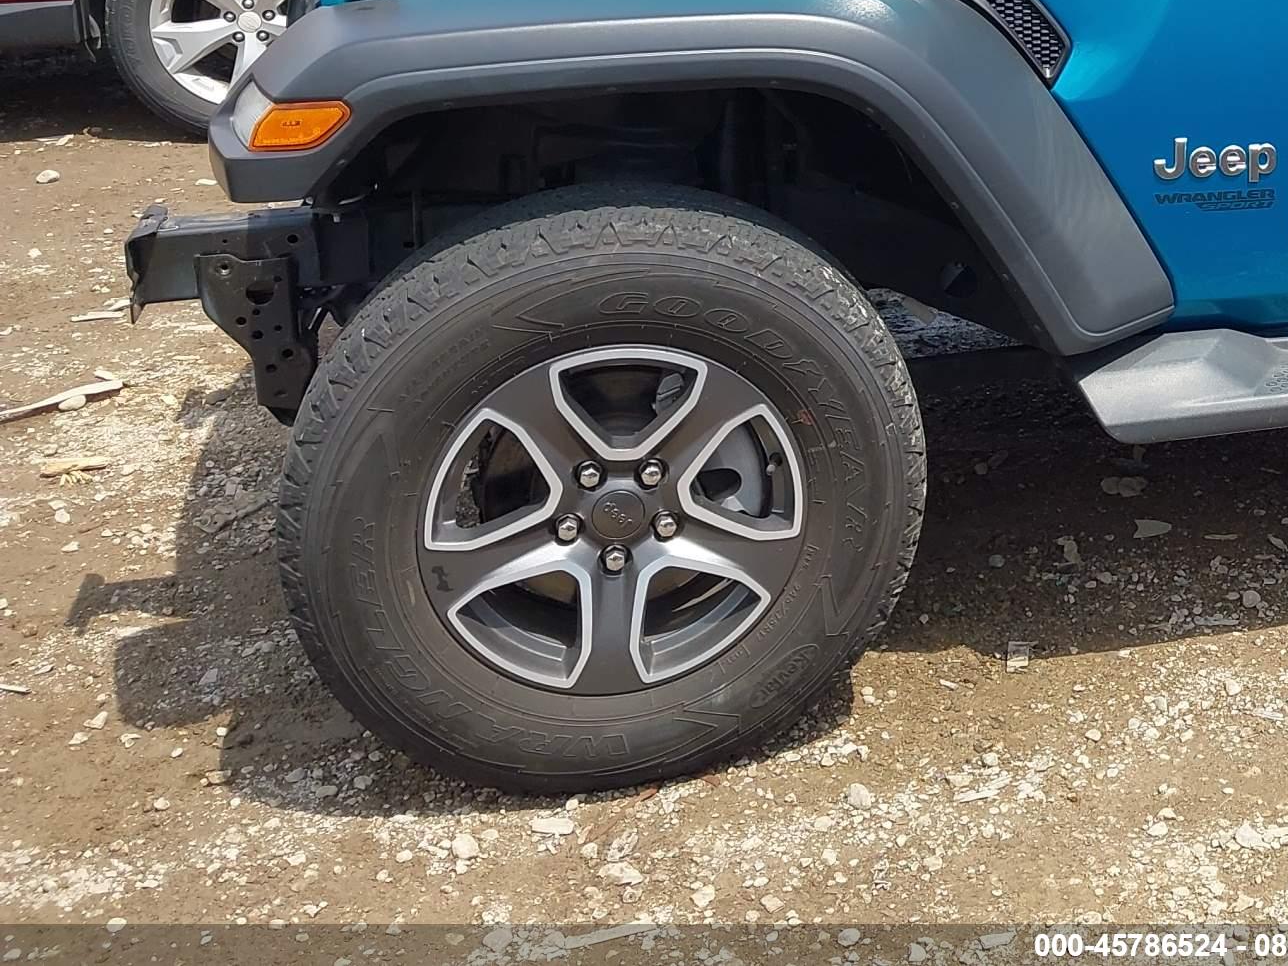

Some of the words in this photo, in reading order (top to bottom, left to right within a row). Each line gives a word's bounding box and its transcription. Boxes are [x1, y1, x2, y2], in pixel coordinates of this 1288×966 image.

[1153, 137, 1277, 183] Jeep
[1154, 188, 1276, 205] WRANGLER
[1199, 200, 1274, 211] SPORT
[597, 291, 868, 552] GOODYEAR
[350, 515, 630, 758] WRANGLER
